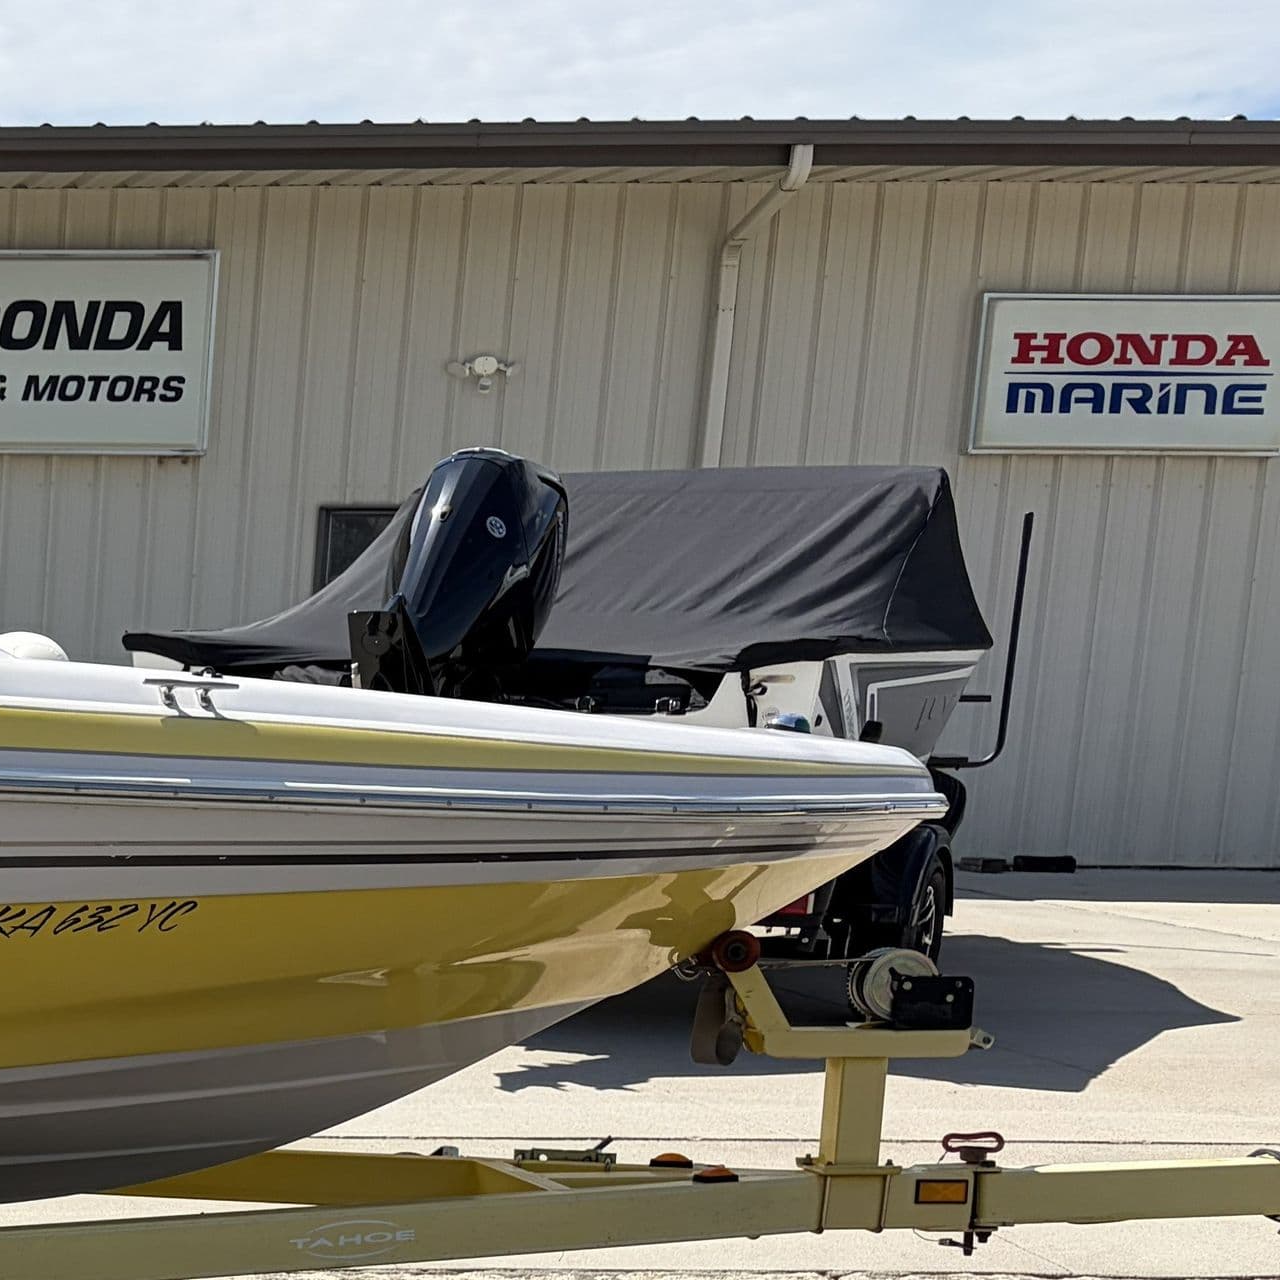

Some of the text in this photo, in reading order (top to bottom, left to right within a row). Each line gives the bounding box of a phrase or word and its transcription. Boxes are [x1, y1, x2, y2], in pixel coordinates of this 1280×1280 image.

[1010, 332, 1271, 367] HONDA
[21, 375, 186, 403] MOTORS
[1005, 382, 1268, 415] MARINE
[53, 903, 139, 936] 632
[138, 900, 198, 933] YC
[289, 1229, 417, 1249] TAHOE
